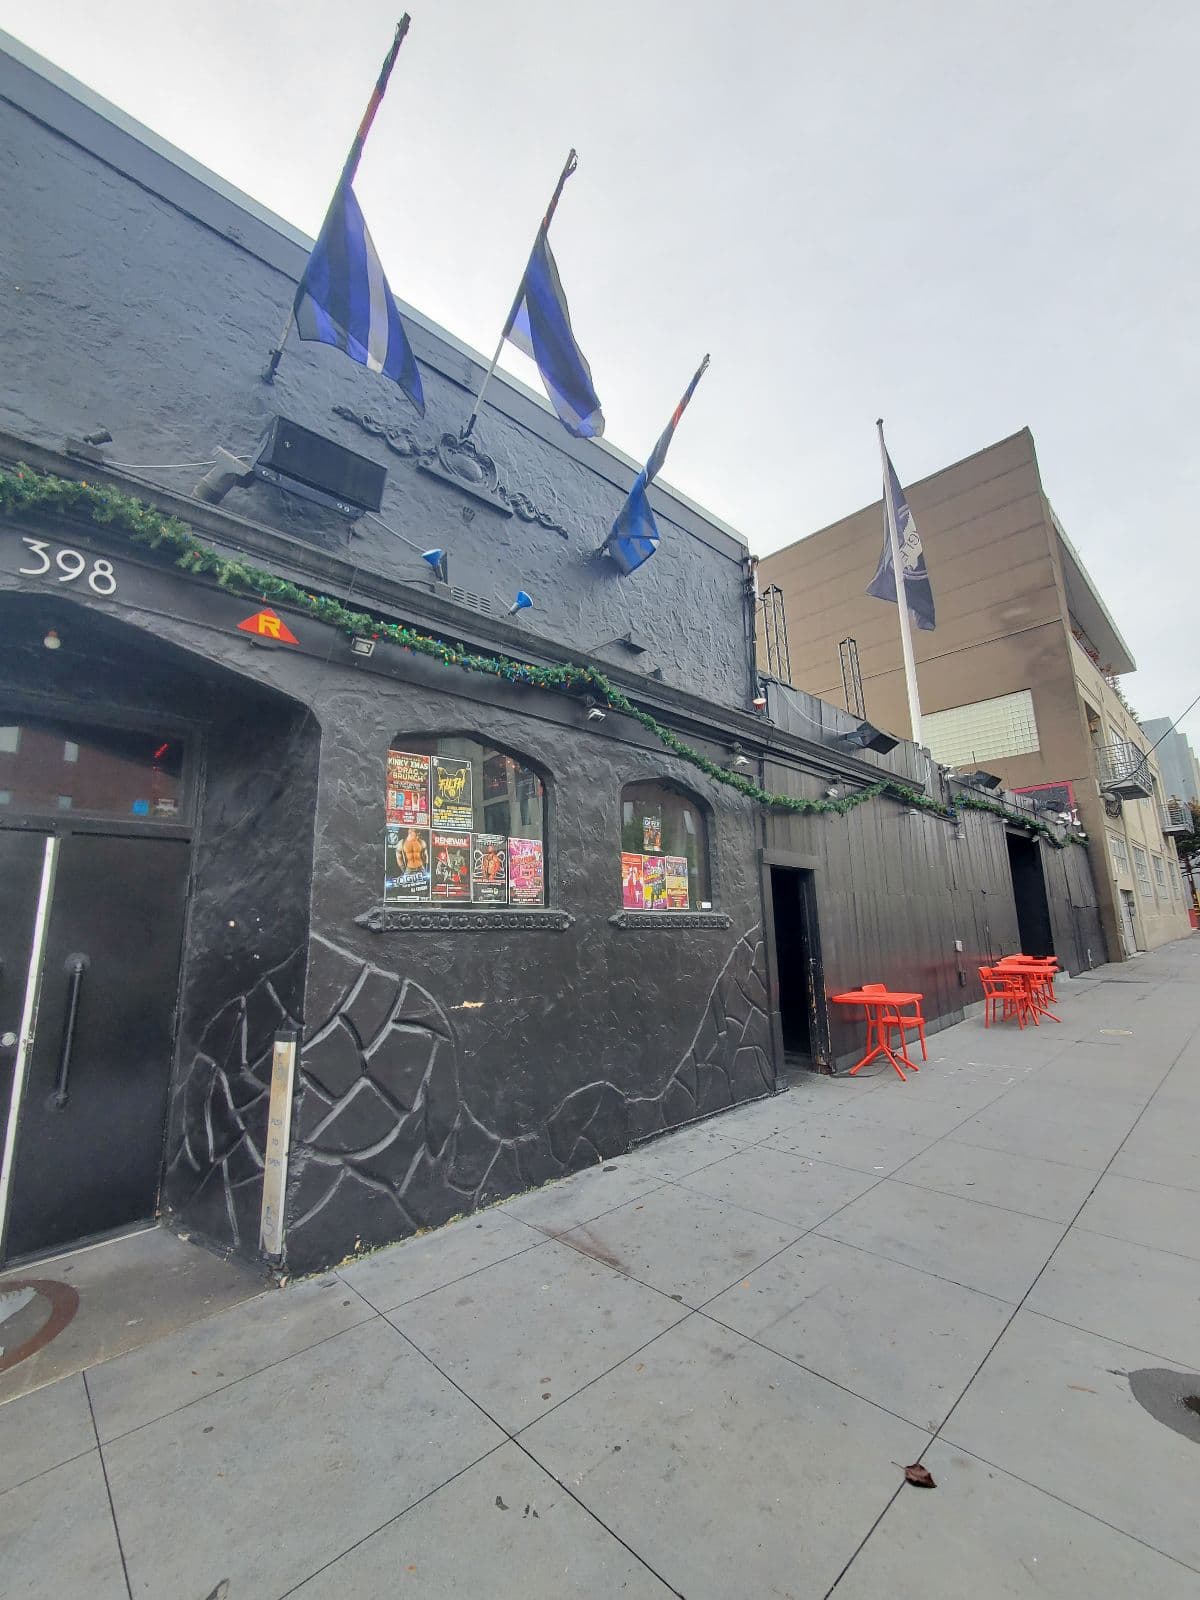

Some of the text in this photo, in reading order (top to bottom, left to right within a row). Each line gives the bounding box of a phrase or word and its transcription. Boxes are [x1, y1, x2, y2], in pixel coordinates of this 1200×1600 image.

[19, 537, 117, 595] 398
[258, 613, 280, 639] R
[388, 757, 409, 767] KINKY
[410, 760, 429, 770] XMAS
[392, 772, 424, 782] BRUNCH
[397, 766, 419, 776] DRAG
